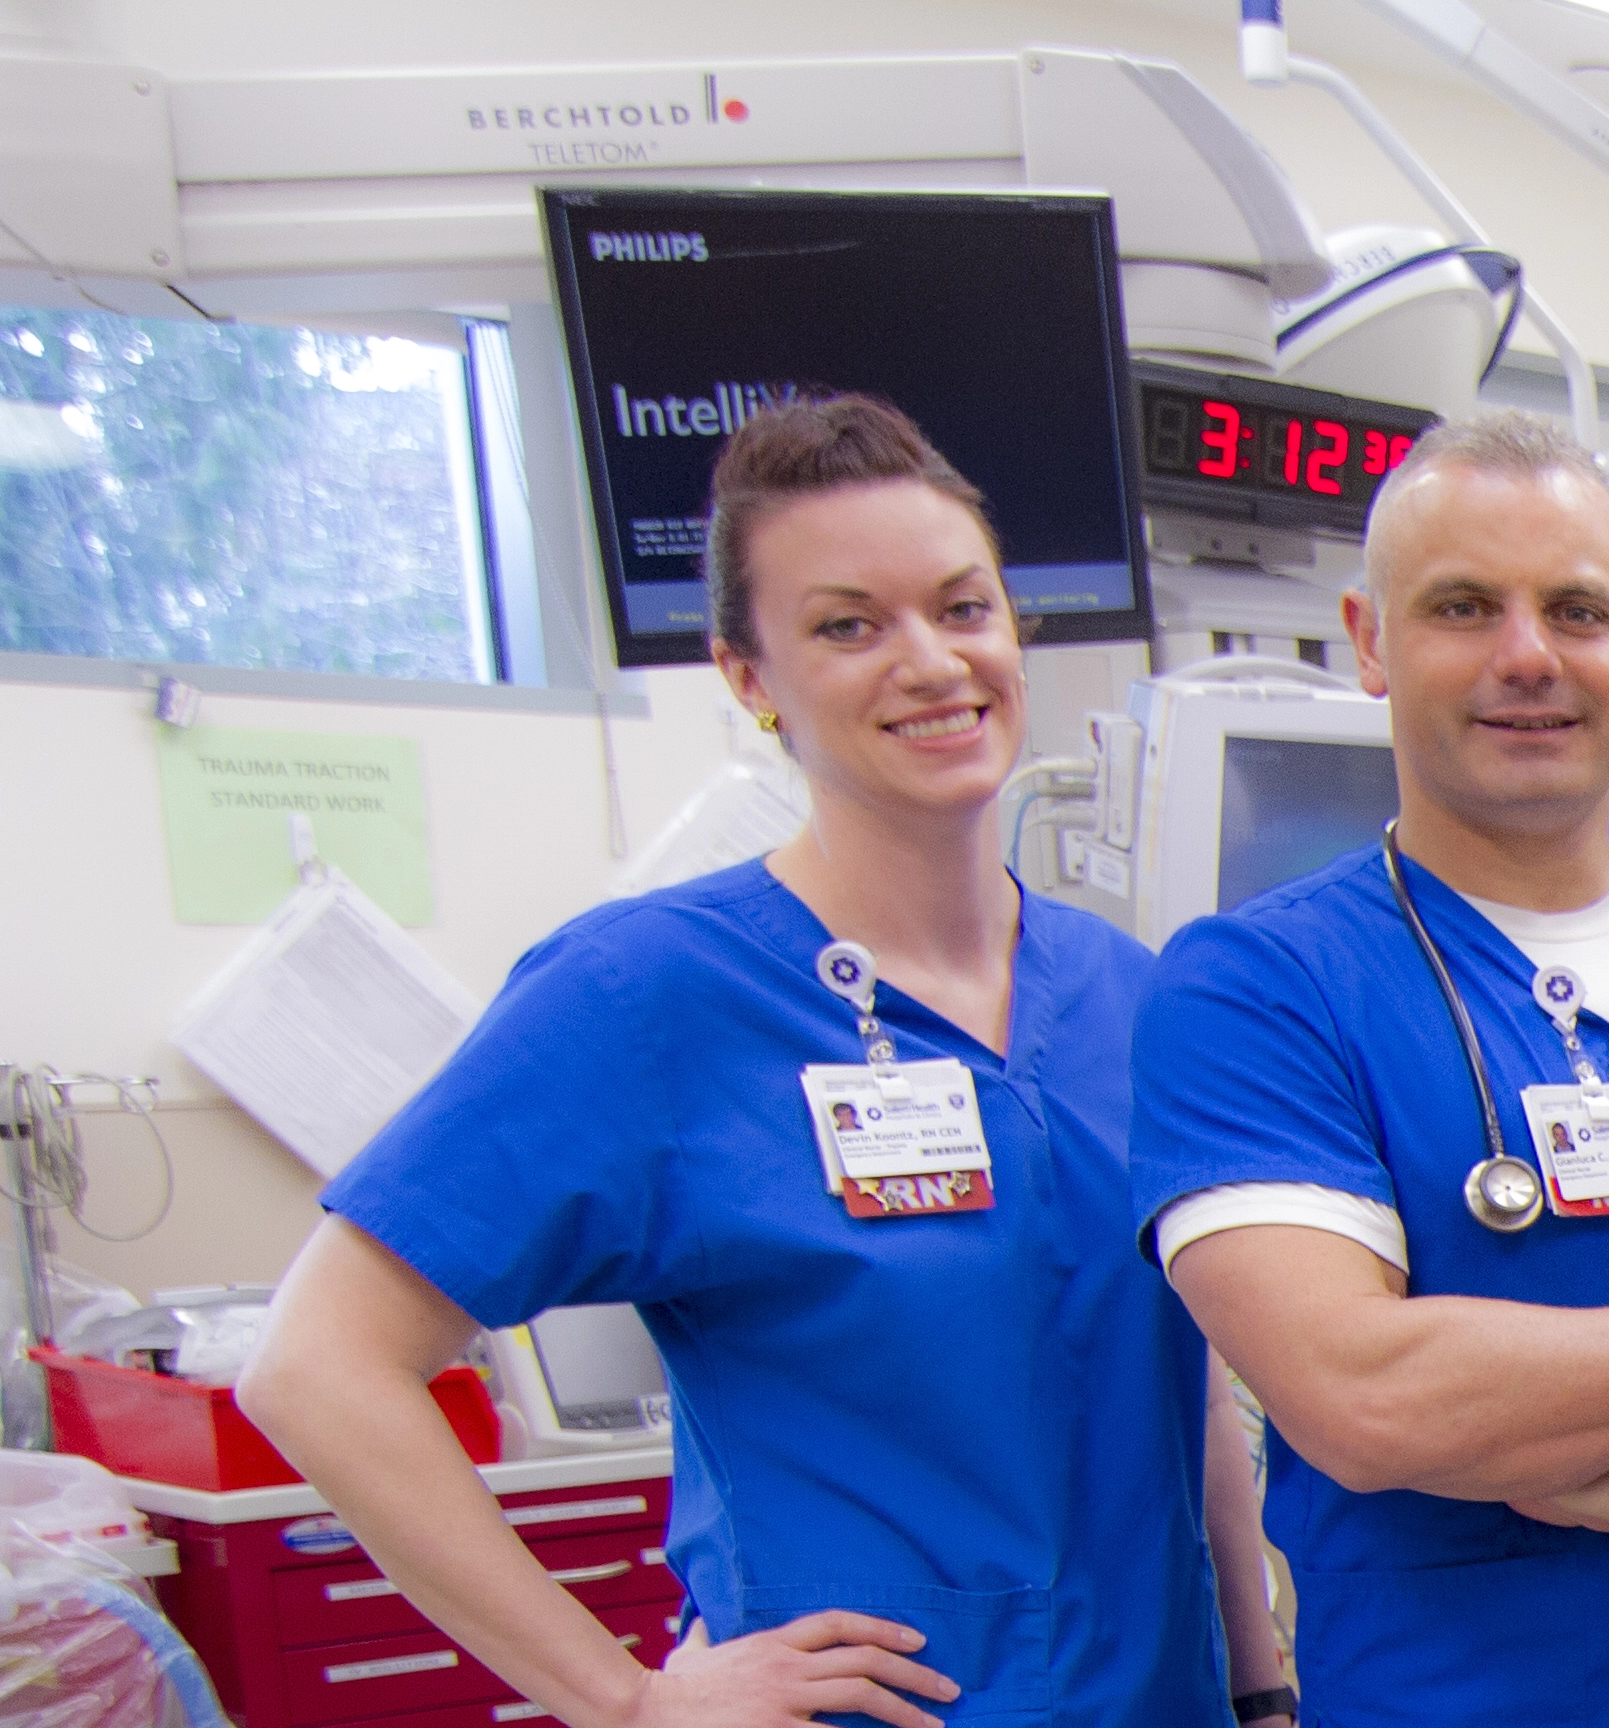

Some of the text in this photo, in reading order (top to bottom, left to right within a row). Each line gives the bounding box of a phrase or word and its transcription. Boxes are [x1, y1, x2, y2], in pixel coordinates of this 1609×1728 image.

[468, 105, 690, 130] BERCHTOLD
[589, 231, 709, 262] PHILIPS
[199, 757, 390, 782] TRAUMA TRACTION
[211, 791, 385, 812] STANDARD WORK
[880, 1174, 955, 1209] RN
